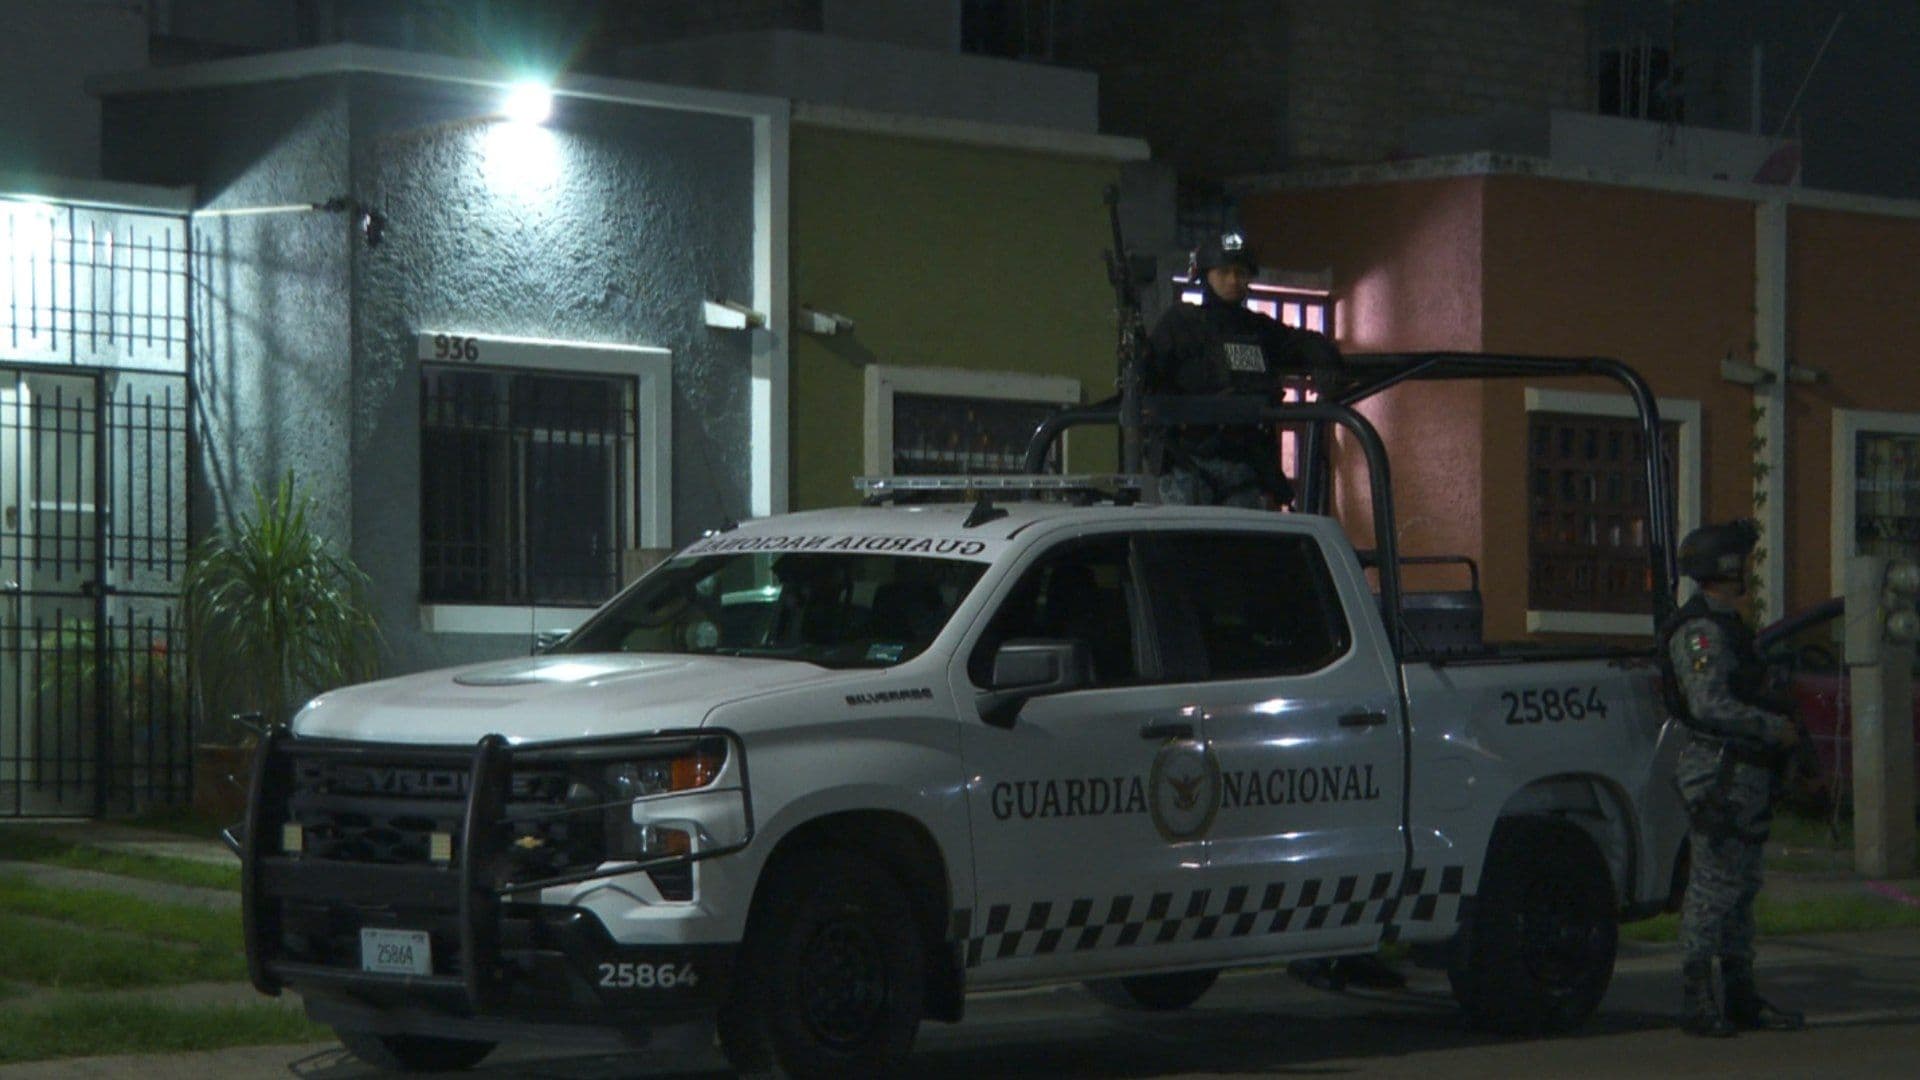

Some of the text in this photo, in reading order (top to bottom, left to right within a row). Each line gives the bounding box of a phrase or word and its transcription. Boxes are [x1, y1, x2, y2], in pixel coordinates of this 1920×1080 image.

[434, 333, 480, 361] 936
[1501, 685, 1608, 725] 25864
[991, 764, 1381, 820] GUARDIA NACIONAL
[598, 962, 699, 988] 25864
